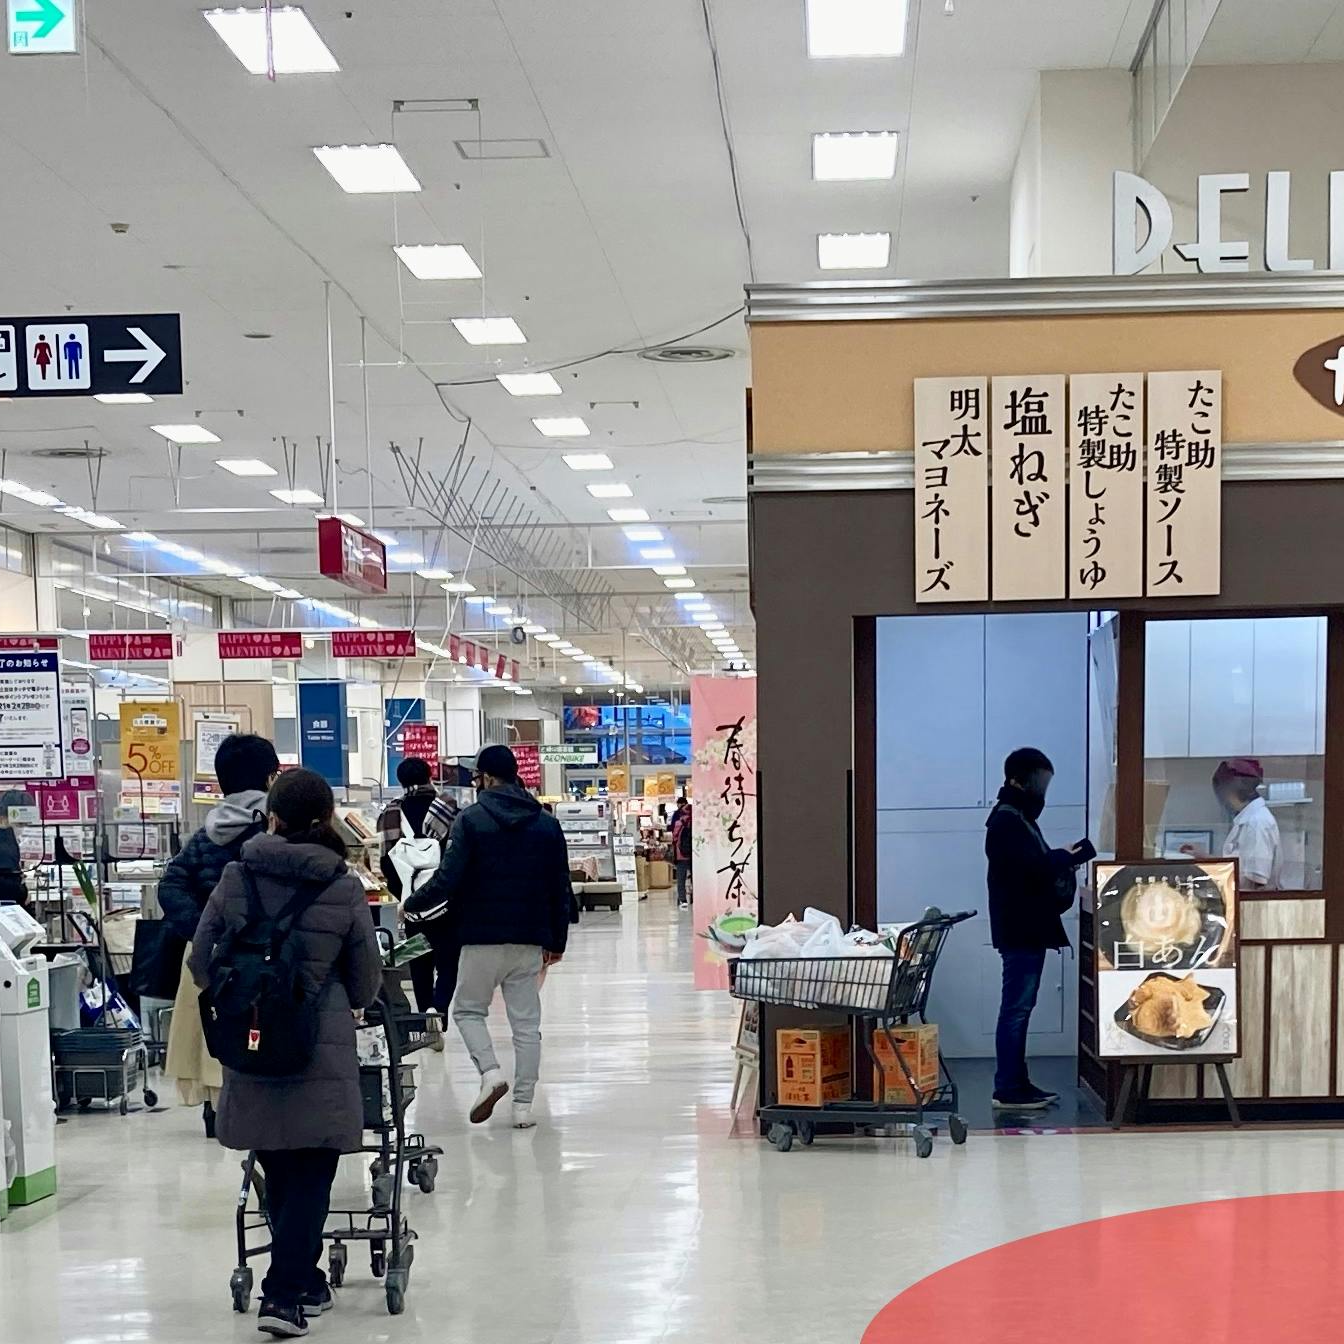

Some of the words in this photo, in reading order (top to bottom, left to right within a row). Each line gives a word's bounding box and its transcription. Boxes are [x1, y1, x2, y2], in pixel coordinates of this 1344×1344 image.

[949, 387, 984, 458] 明太
[1002, 386, 1053, 539] 塩ねぎ
[1077, 404, 1110, 591] 特製しょうゆ
[1108, 382, 1138, 473] たこ助
[1184, 379, 1216, 471] たこ助
[920, 438, 955, 594] マヨネーズ
[1152, 428, 1187, 587] 特製ソース
[149, 760, 175, 774] OFF
[716, 715, 757, 908] 春待ち茶
